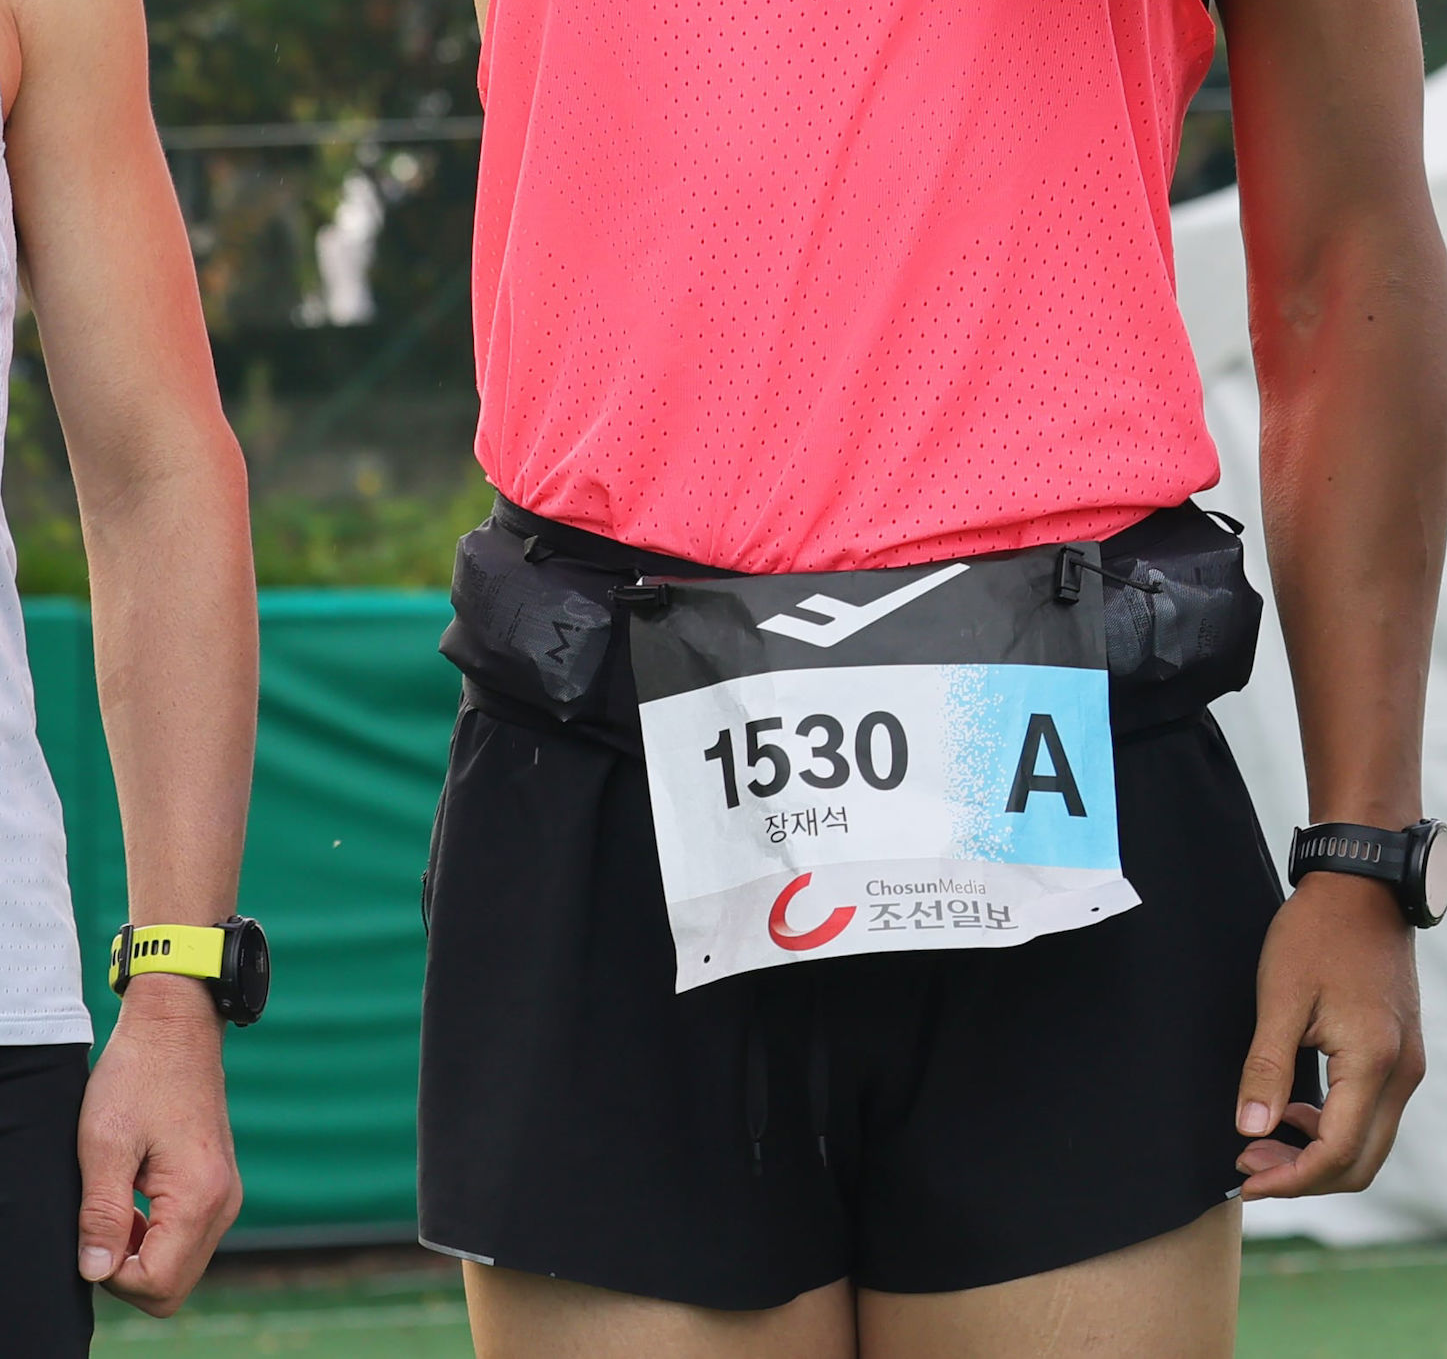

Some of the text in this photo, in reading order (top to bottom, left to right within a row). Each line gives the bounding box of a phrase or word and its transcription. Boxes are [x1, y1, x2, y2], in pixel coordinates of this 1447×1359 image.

[703, 710, 909, 811] 1530
[1004, 713, 1088, 818] A
[764, 805, 849, 844] 장재석
[865, 878, 987, 898] ChosunMedia
[867, 899, 1019, 932] 조선일보
